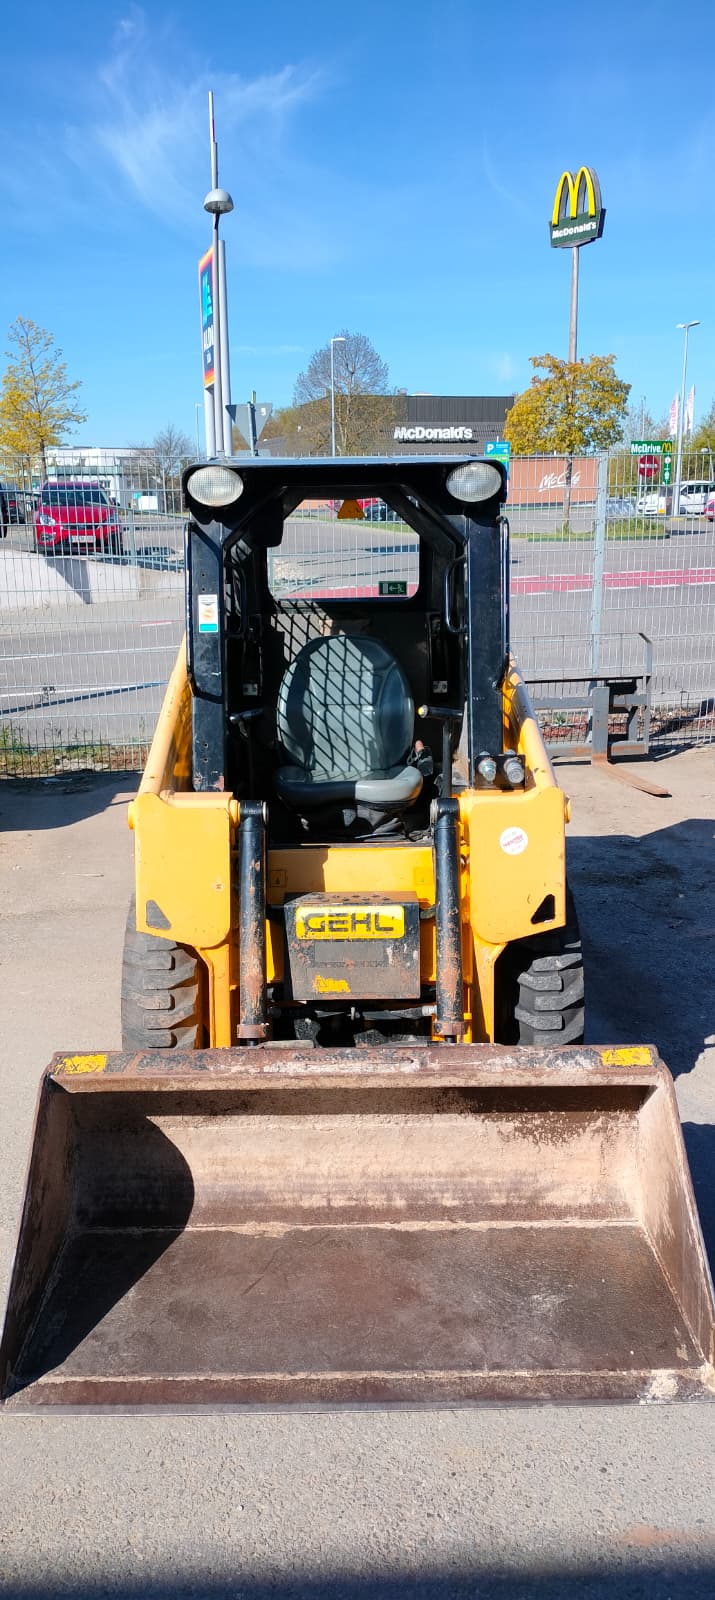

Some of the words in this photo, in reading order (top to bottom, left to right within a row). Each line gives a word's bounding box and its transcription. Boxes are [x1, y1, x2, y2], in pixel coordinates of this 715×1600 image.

[551, 221, 597, 239] McDonald's
[393, 426, 473, 440] McDonald's
[487, 444, 494, 454] P
[631, 443, 661, 453] McDrive
[304, 912, 394, 933] GEHL
